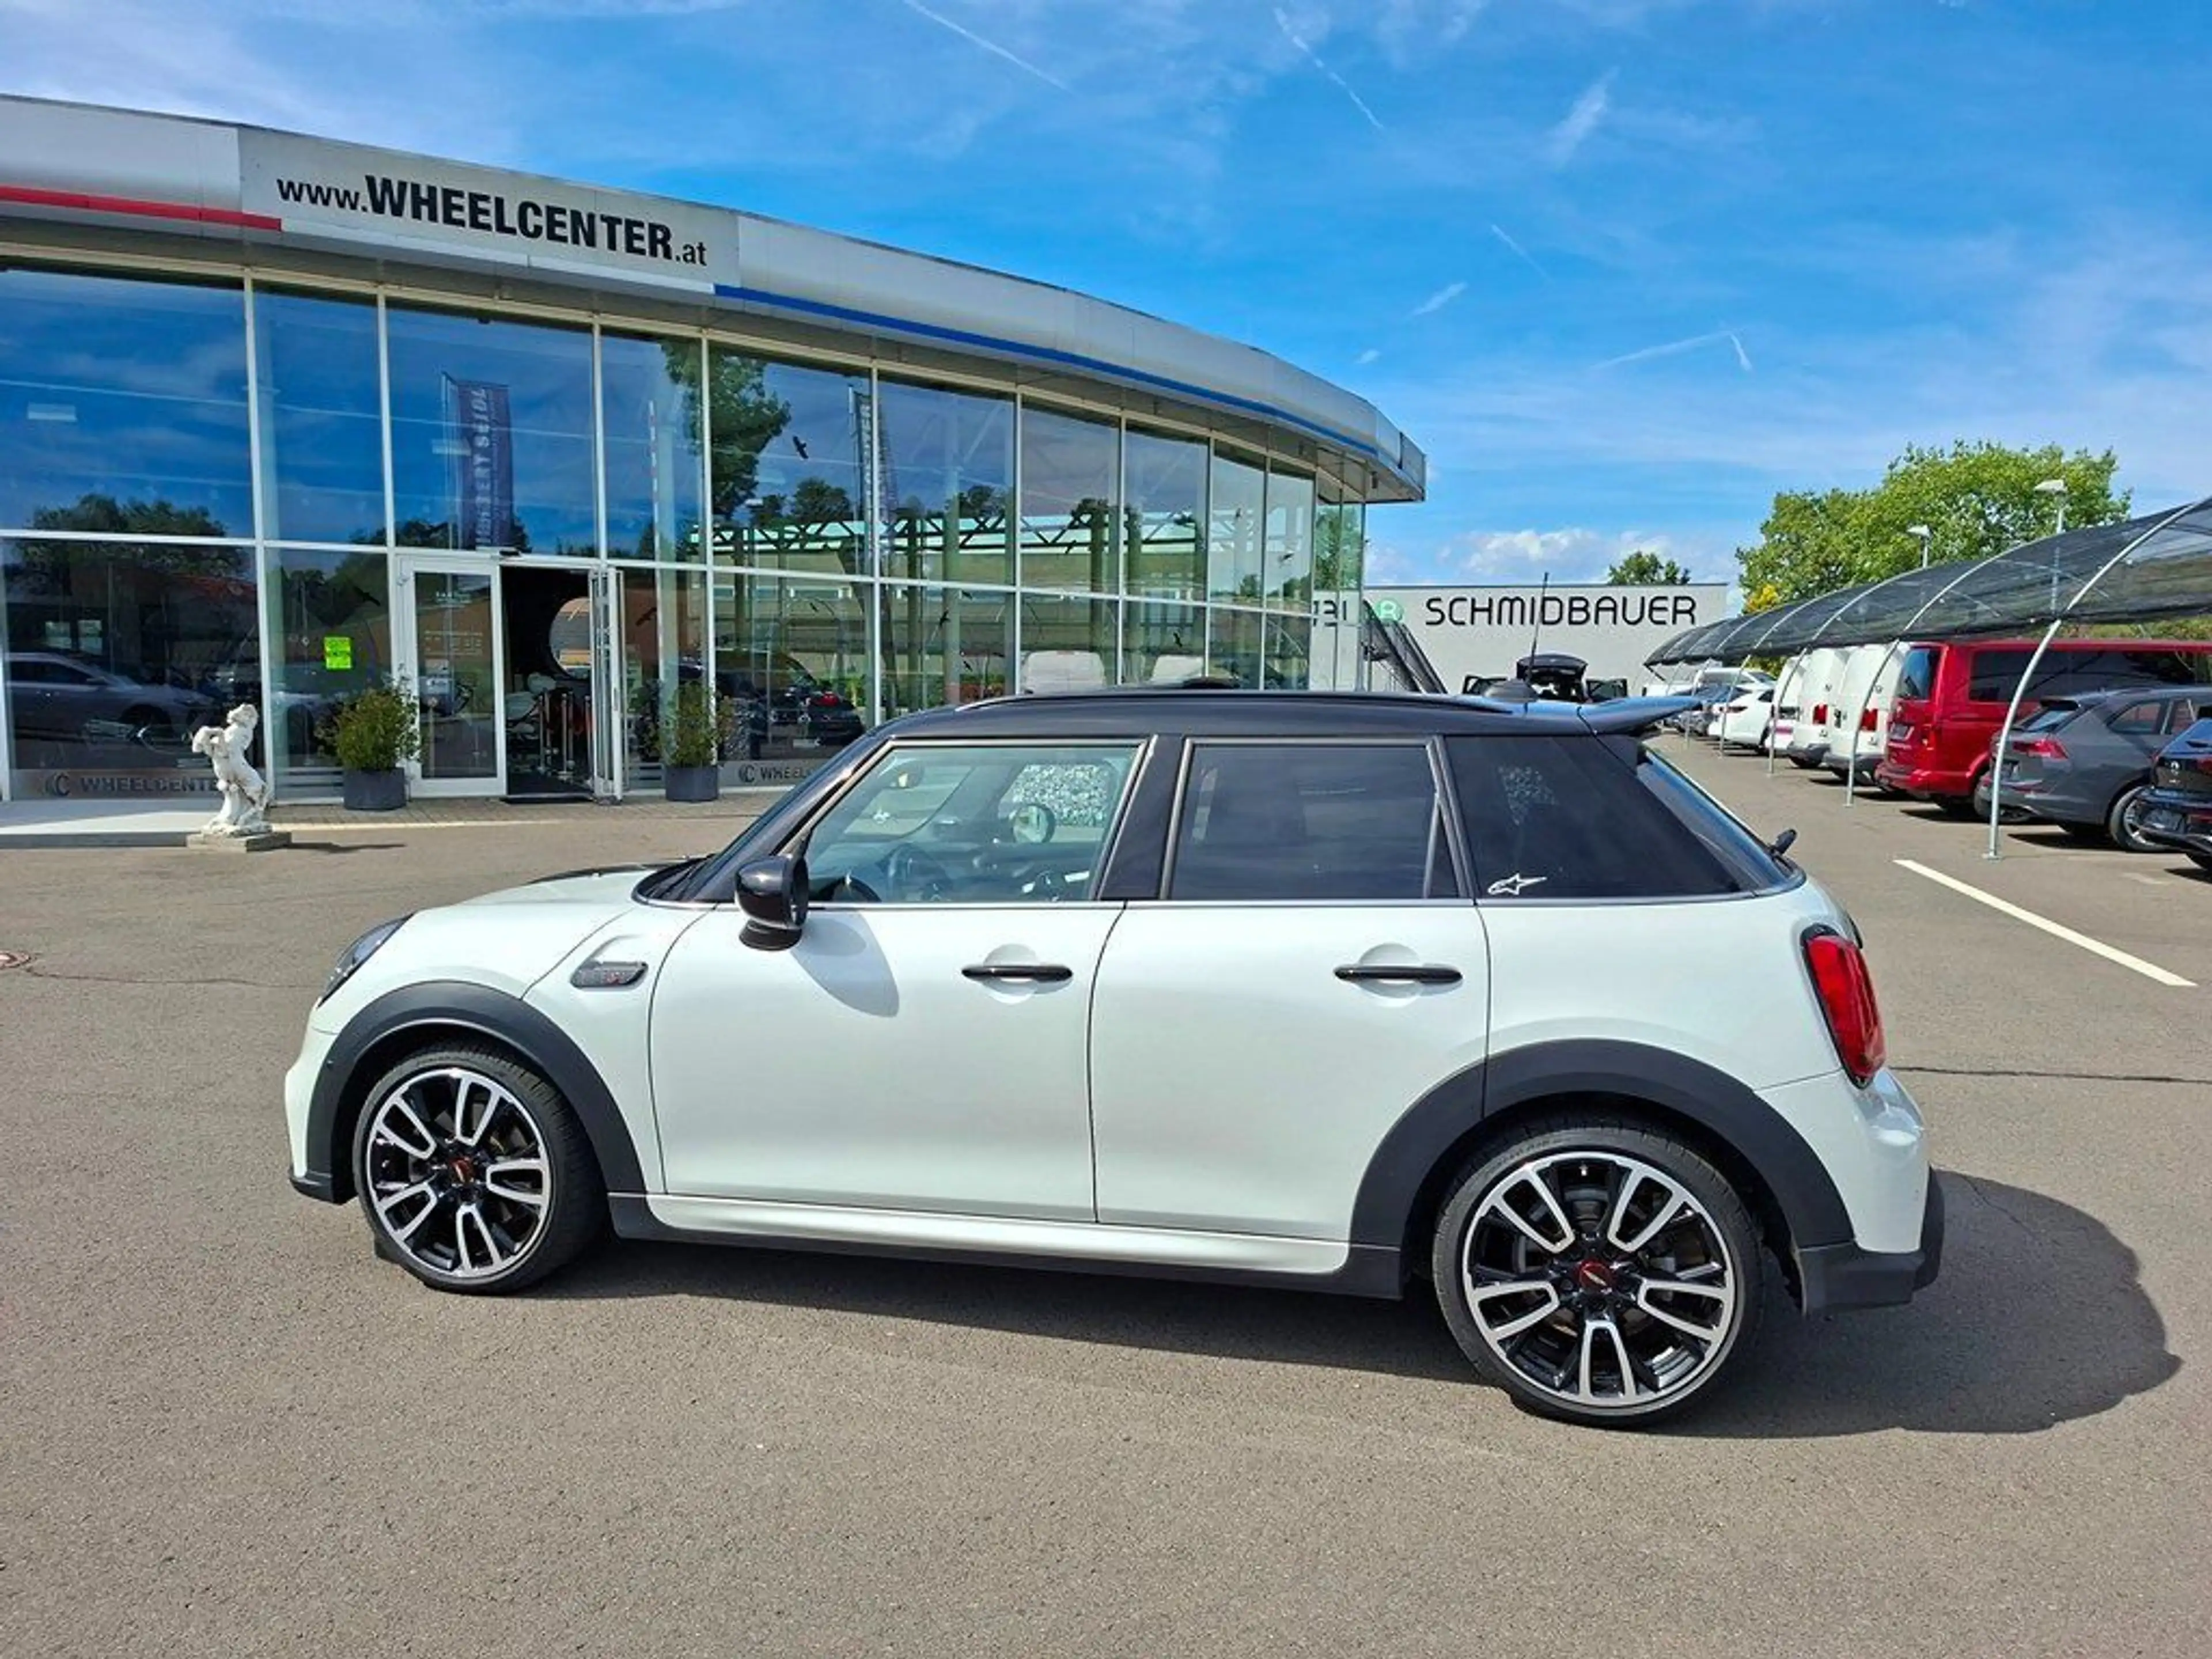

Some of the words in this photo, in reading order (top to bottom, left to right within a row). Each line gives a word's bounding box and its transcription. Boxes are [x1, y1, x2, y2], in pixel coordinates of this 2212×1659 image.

[276, 174, 707, 266] www.WHEELCENTER.at
[1425, 596, 1696, 626] SCHMIDBAUER
[79, 775, 218, 792] WHEELCENTE
